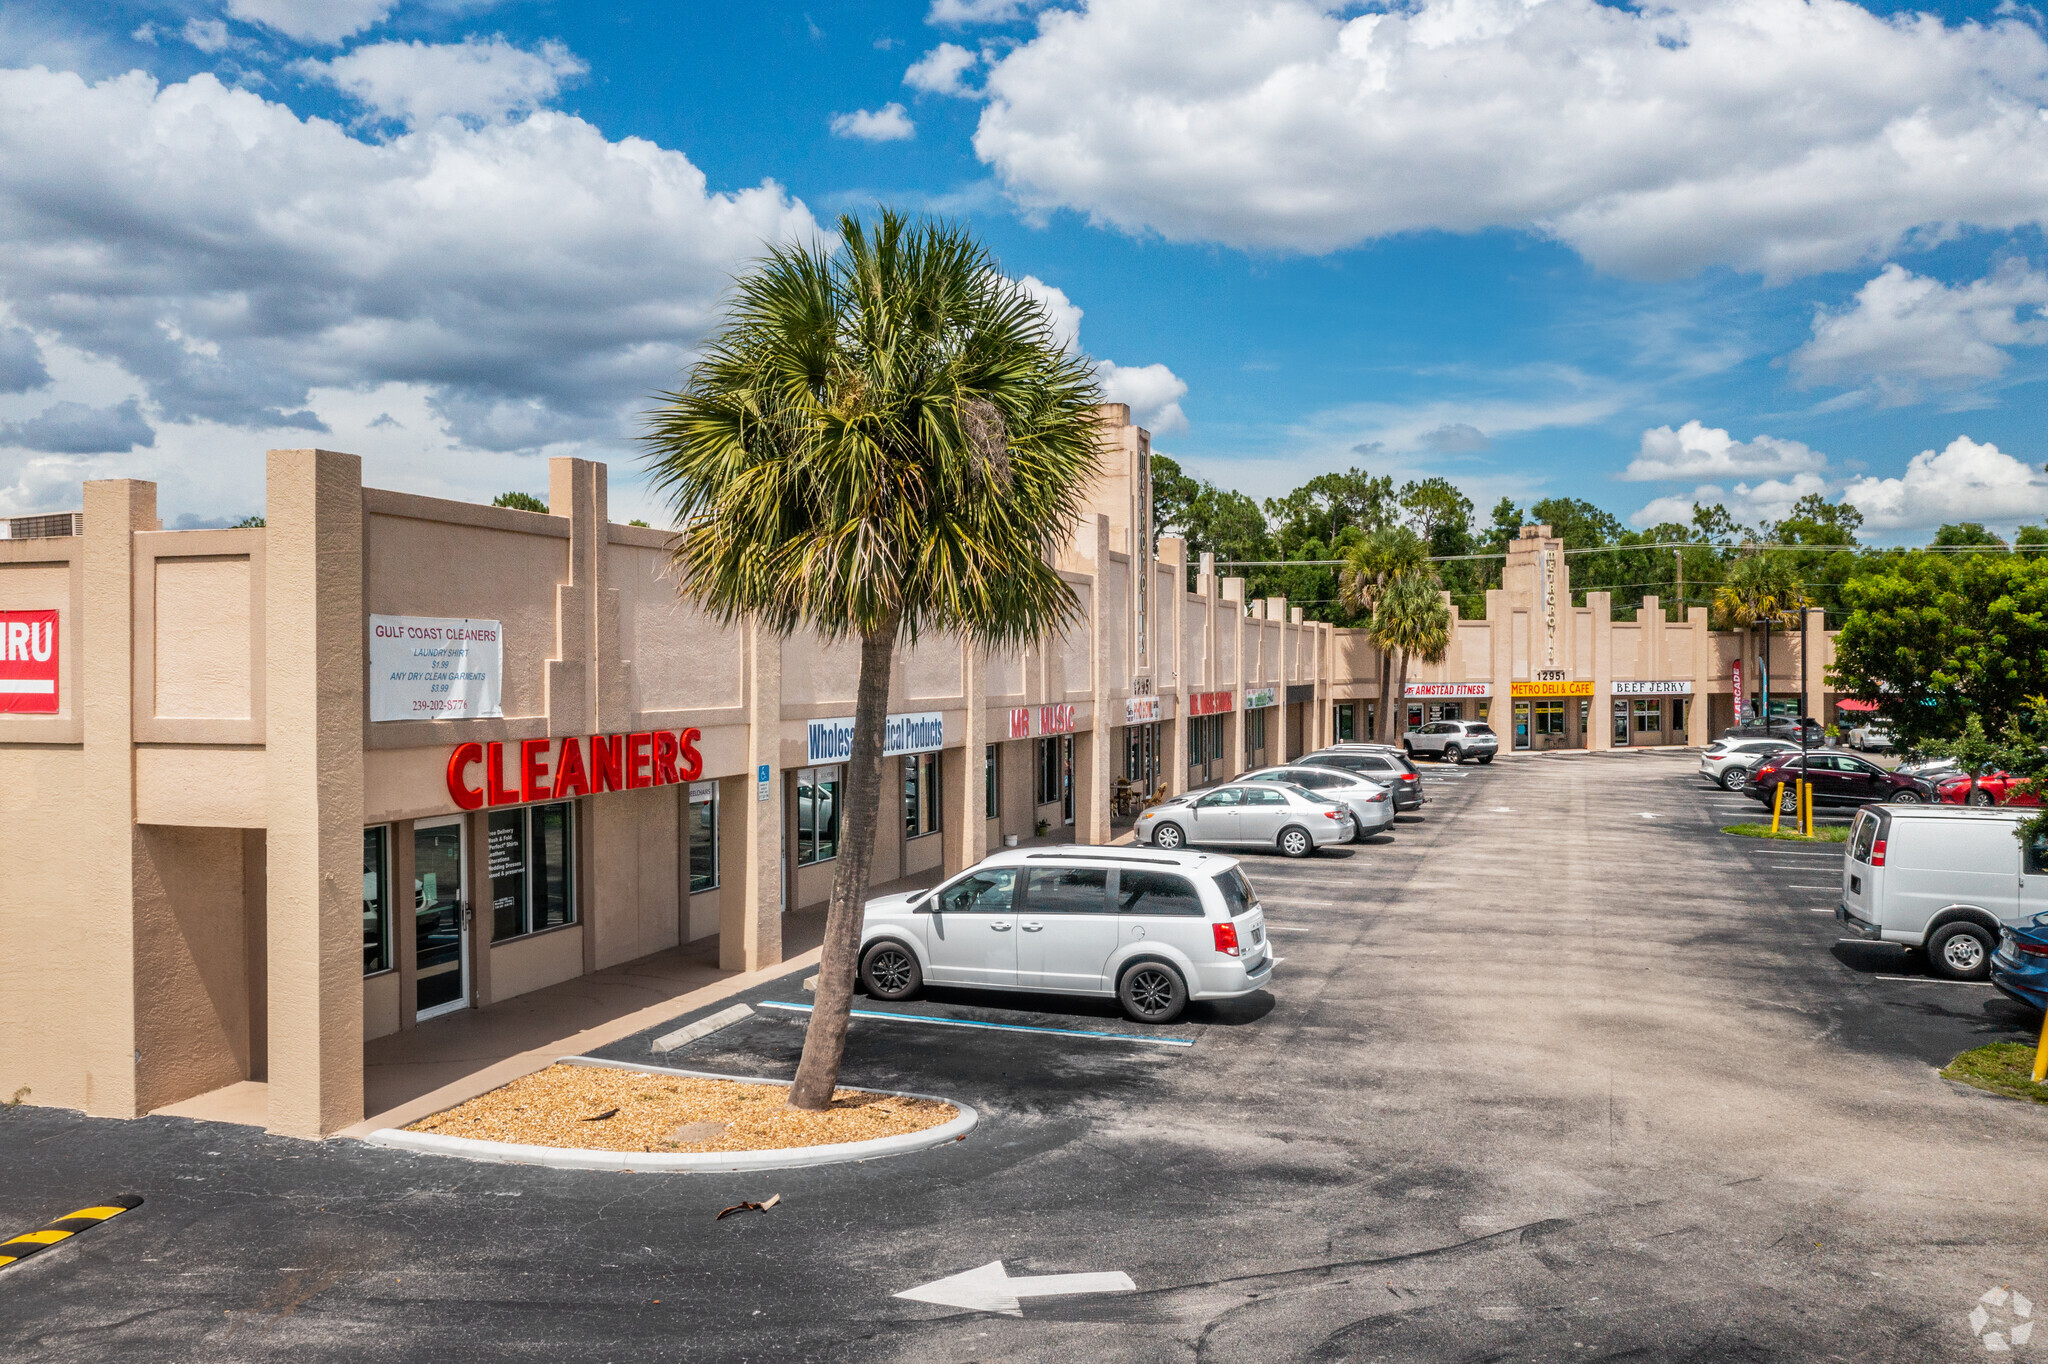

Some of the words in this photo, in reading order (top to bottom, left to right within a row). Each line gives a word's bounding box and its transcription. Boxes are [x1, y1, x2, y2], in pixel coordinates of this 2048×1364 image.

[375, 625, 404, 638] GULF
[407, 627, 442, 640] COAST
[446, 628, 496, 642] CLEANERS
[0, 621, 52, 662] RU
[413, 648, 446, 657] LAUNDRY
[447, 649, 469, 657] SHIRT
[431, 660, 450, 669] $1.99
[390, 672, 407, 681] ANY
[407, 672, 424, 681] DRY
[424, 672, 447, 681] CLEAN
[448, 672, 486, 681] GARMENTS
[1537, 671, 1566, 681] 12951
[430, 684, 449, 693] $3.99
[1415, 685, 1454, 695] ARMSTEAD
[1456, 684, 1486, 695] FITNESS
[1511, 684, 1540, 695] METRO
[1542, 683, 1559, 694] DELI
[1561, 683, 1566, 694] &
[1616, 683, 1646, 693] BEEF
[1649, 682, 1685, 692] JERKY
[1733, 667, 1741, 713] ARCADE
[412, 700, 468, 711] 239-202-8776
[1009, 708, 1030, 738] MR
[1038, 704, 1075, 735] MUSIC
[809, 722, 855, 760] Wholesa
[906, 716, 942, 749] Products
[447, 727, 703, 811] CLEANERS
